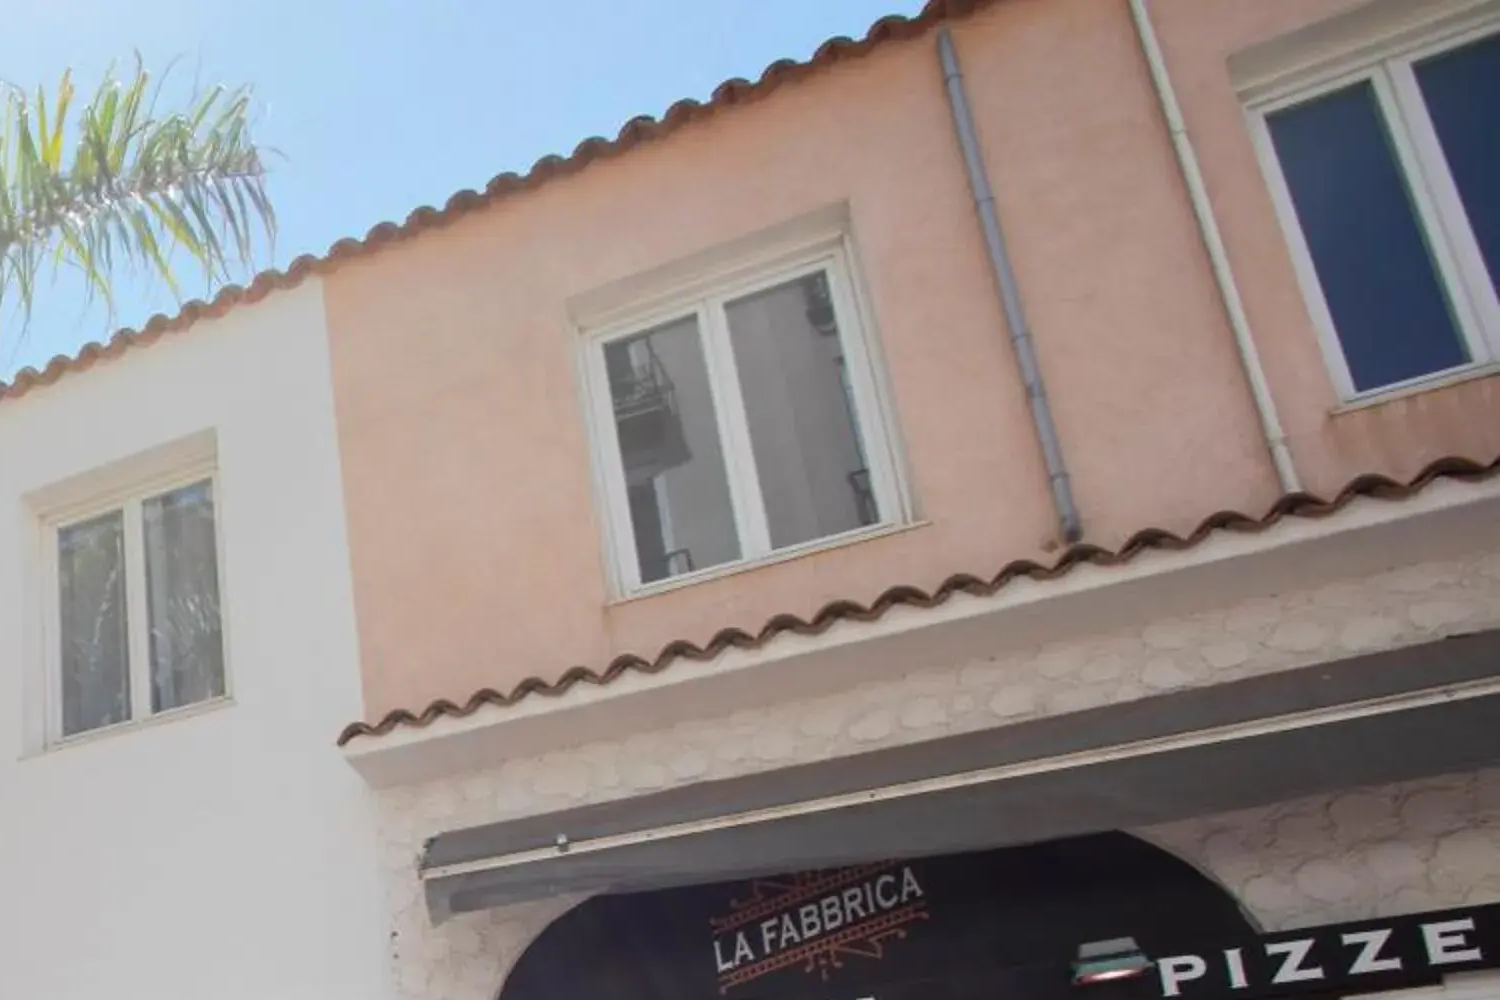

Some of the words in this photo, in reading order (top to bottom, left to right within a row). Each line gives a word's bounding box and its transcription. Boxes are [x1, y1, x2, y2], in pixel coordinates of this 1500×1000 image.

[713, 932, 755, 973] LA
[760, 866, 924, 953] FABBRICA
[1157, 917, 1483, 997] PIZZE
